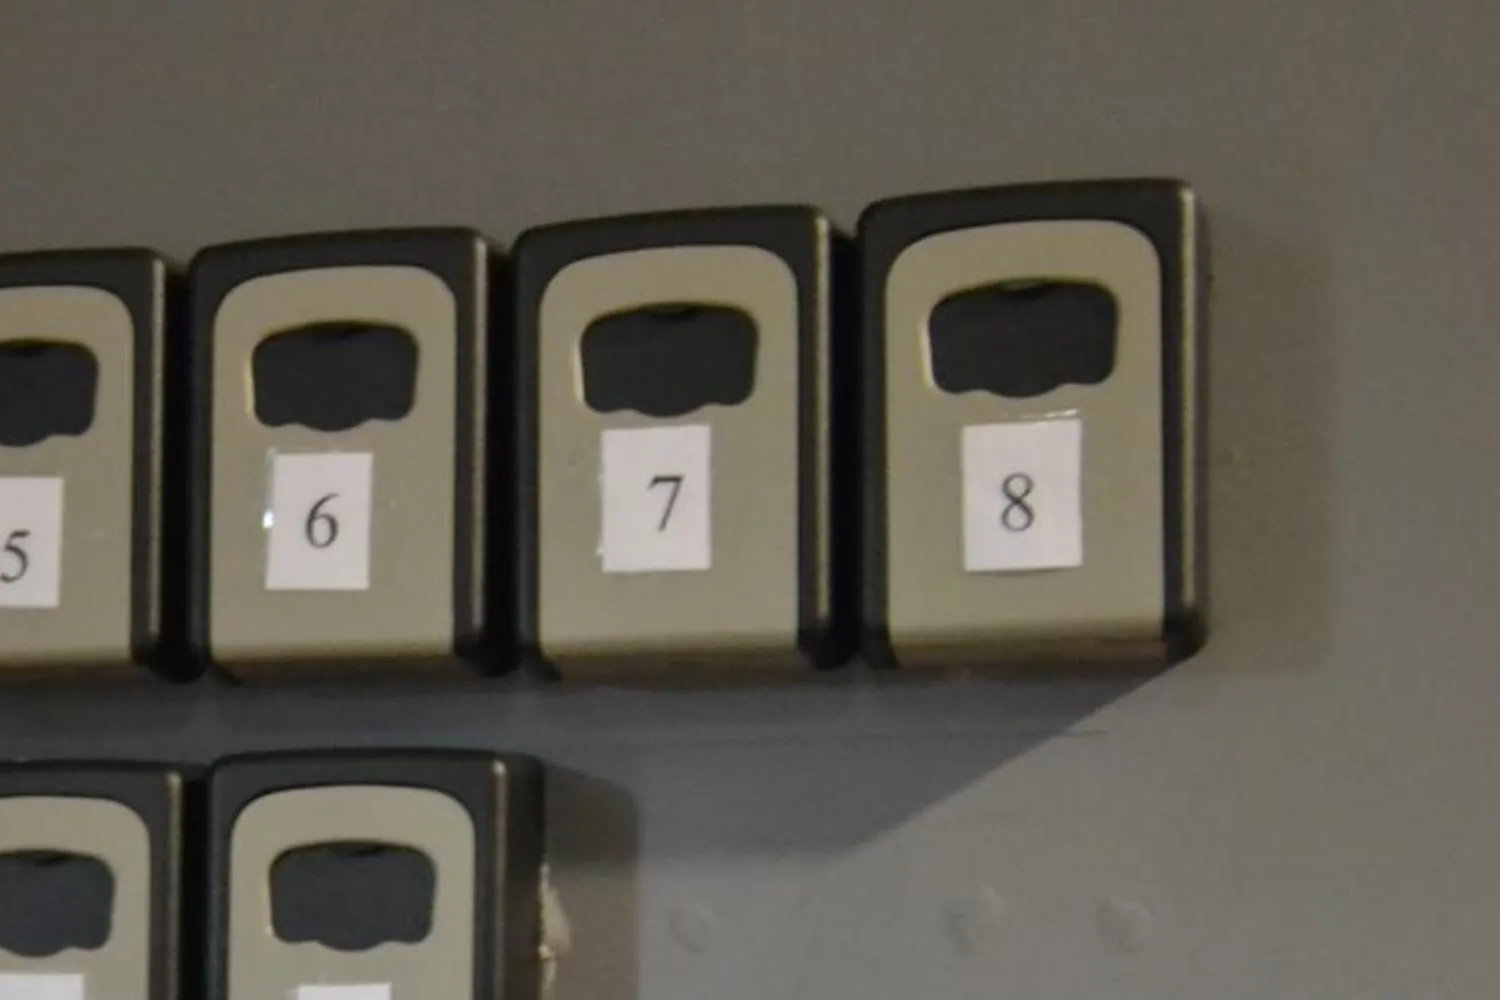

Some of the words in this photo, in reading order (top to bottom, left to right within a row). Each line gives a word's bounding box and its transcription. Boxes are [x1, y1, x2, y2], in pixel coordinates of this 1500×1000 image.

[304, 494, 339, 548] 6
[647, 473, 684, 532] 7
[1001, 473, 1035, 532] 8
[0, 529, 31, 584] 5
